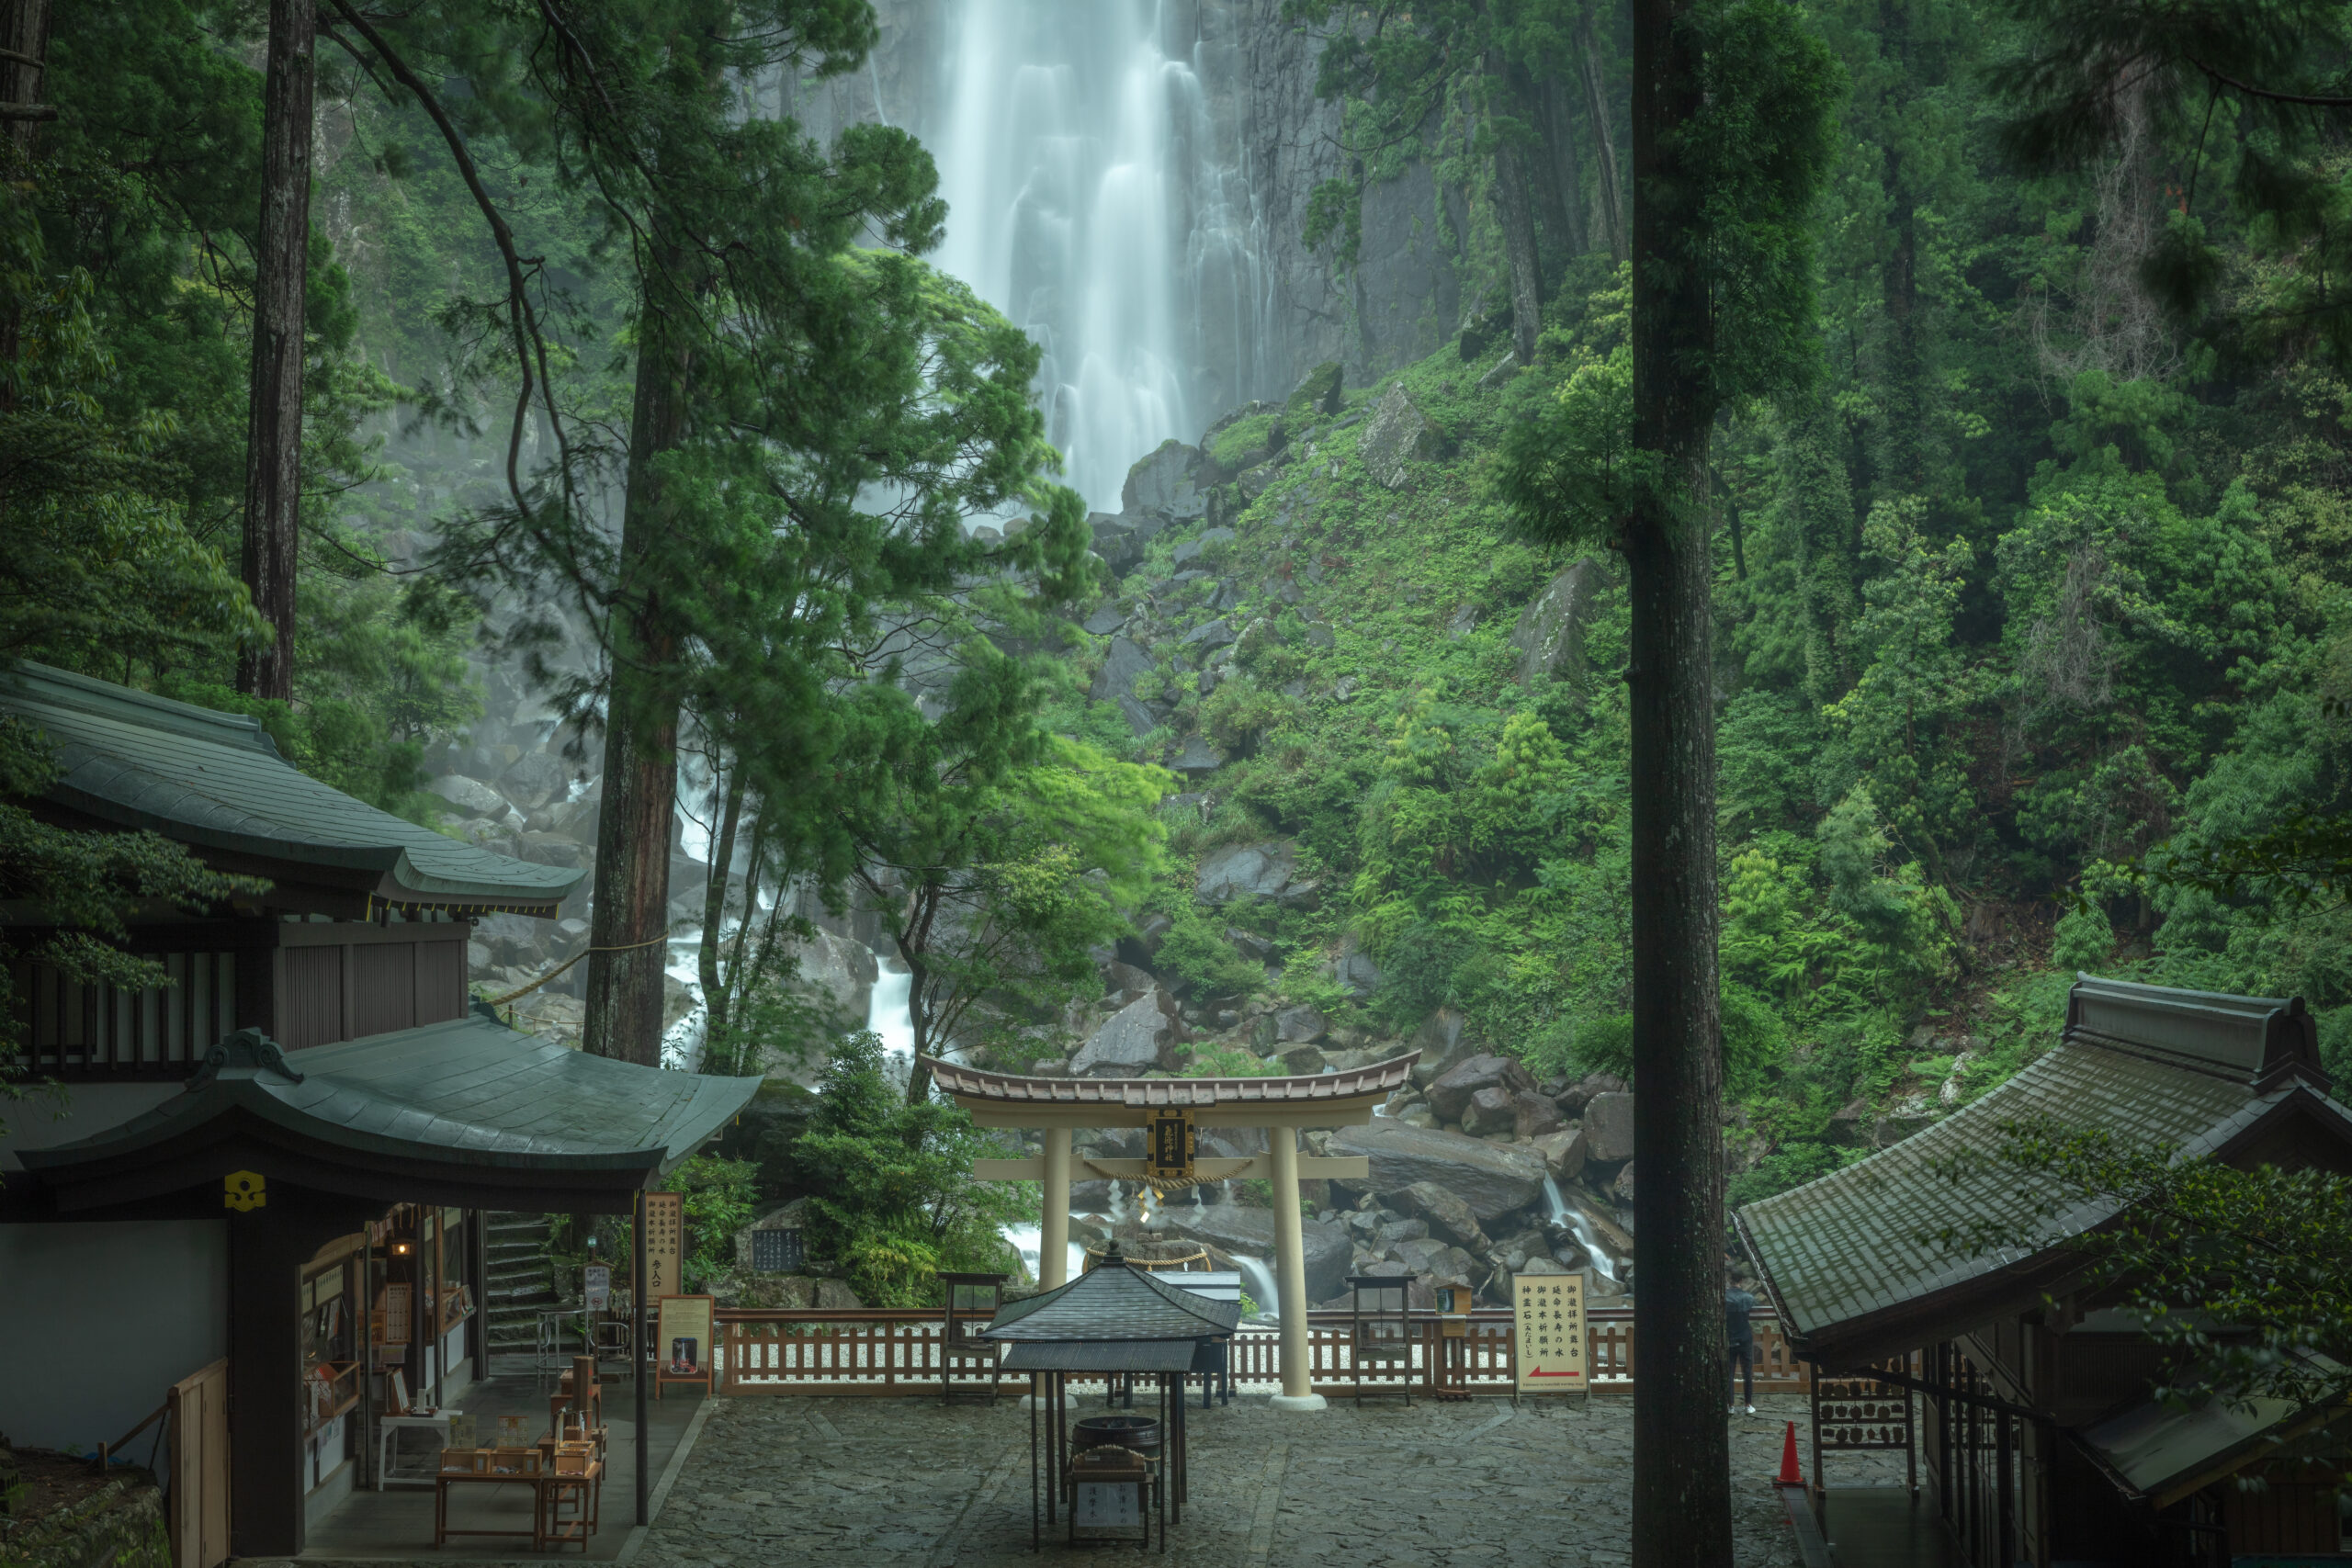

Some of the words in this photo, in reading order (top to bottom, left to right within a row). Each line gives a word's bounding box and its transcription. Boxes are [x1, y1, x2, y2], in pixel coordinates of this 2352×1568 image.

[651, 1259, 662, 1288] 参入口
[1537, 1285, 1549, 1358] 御瀧本祈願所
[1553, 1285, 1564, 1358] 延命長寿の水
